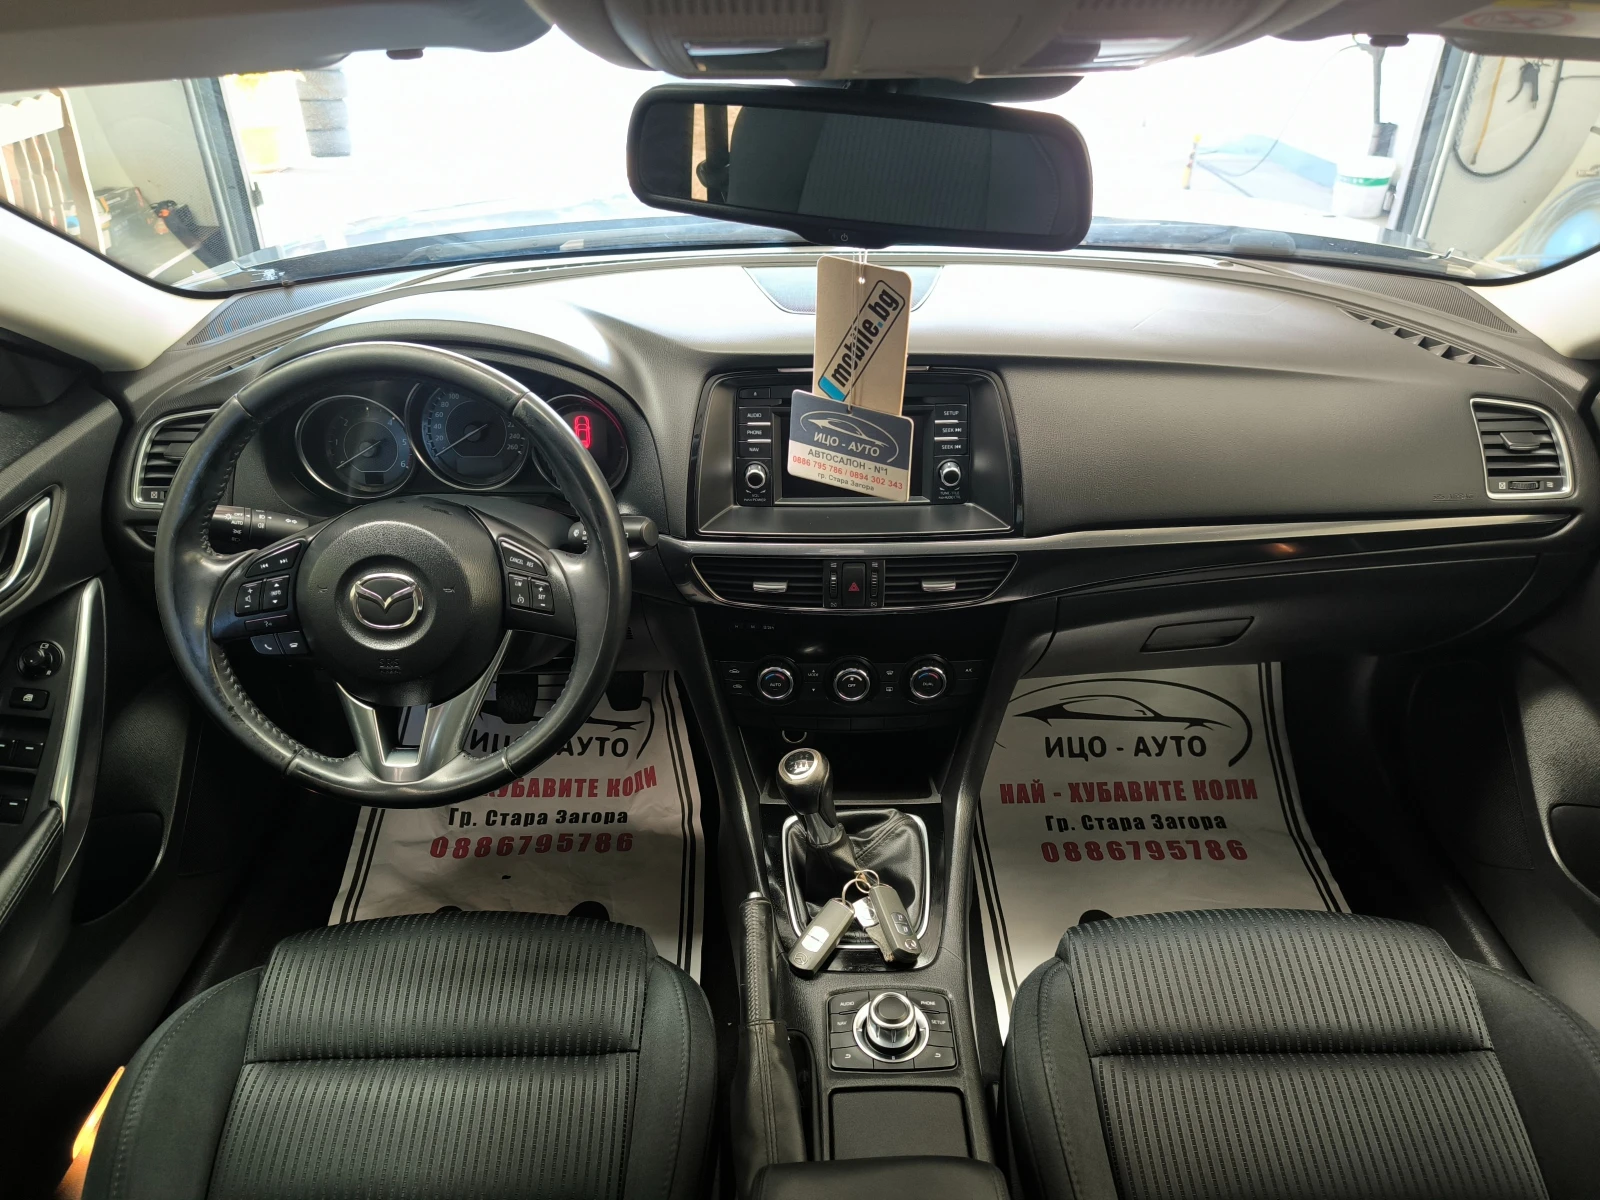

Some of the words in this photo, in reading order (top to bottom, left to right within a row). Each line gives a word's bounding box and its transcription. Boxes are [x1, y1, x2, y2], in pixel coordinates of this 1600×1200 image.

[831, 288, 900, 388] mobile.bg
[387, 418, 393, 427] 4
[435, 411, 444, 419] 60
[402, 438, 407, 446] 5
[435, 434, 444, 442] 20
[814, 432, 839, 447] ИЦО
[848, 441, 880, 457] АУТО
[400, 460, 407, 468] 6
[808, 449, 866, 470] АВТОСАЛОН
[792, 455, 811, 468] 0886
[812, 460, 827, 472] 795
[828, 464, 843, 475] 786
[849, 469, 869, 481] 0894
[871, 475, 885, 486] 302
[887, 478, 903, 490] 343
[817, 473, 827, 481] гр.
[828, 474, 850, 485] Стара
[850, 479, 875, 491] Загора
[510, 556, 523, 565] CANCEL
[1044, 735, 1107, 762] ИЦО
[1133, 735, 1207, 758] АУТО
[606, 765, 657, 798] КОЛИ
[999, 779, 1046, 804] НАЙ
[1068, 780, 1187, 803] ХУБАВИТЕ
[1192, 778, 1259, 800] КОЛИ
[448, 807, 477, 828] Гр.
[485, 809, 548, 827] Стара
[555, 809, 628, 825] Загора
[1045, 815, 1075, 833] Гр.
[1081, 814, 1146, 832] Стара
[1152, 814, 1228, 831] Загора
[429, 832, 634, 860] 0886795786
[1040, 839, 1248, 863] 0886795786
